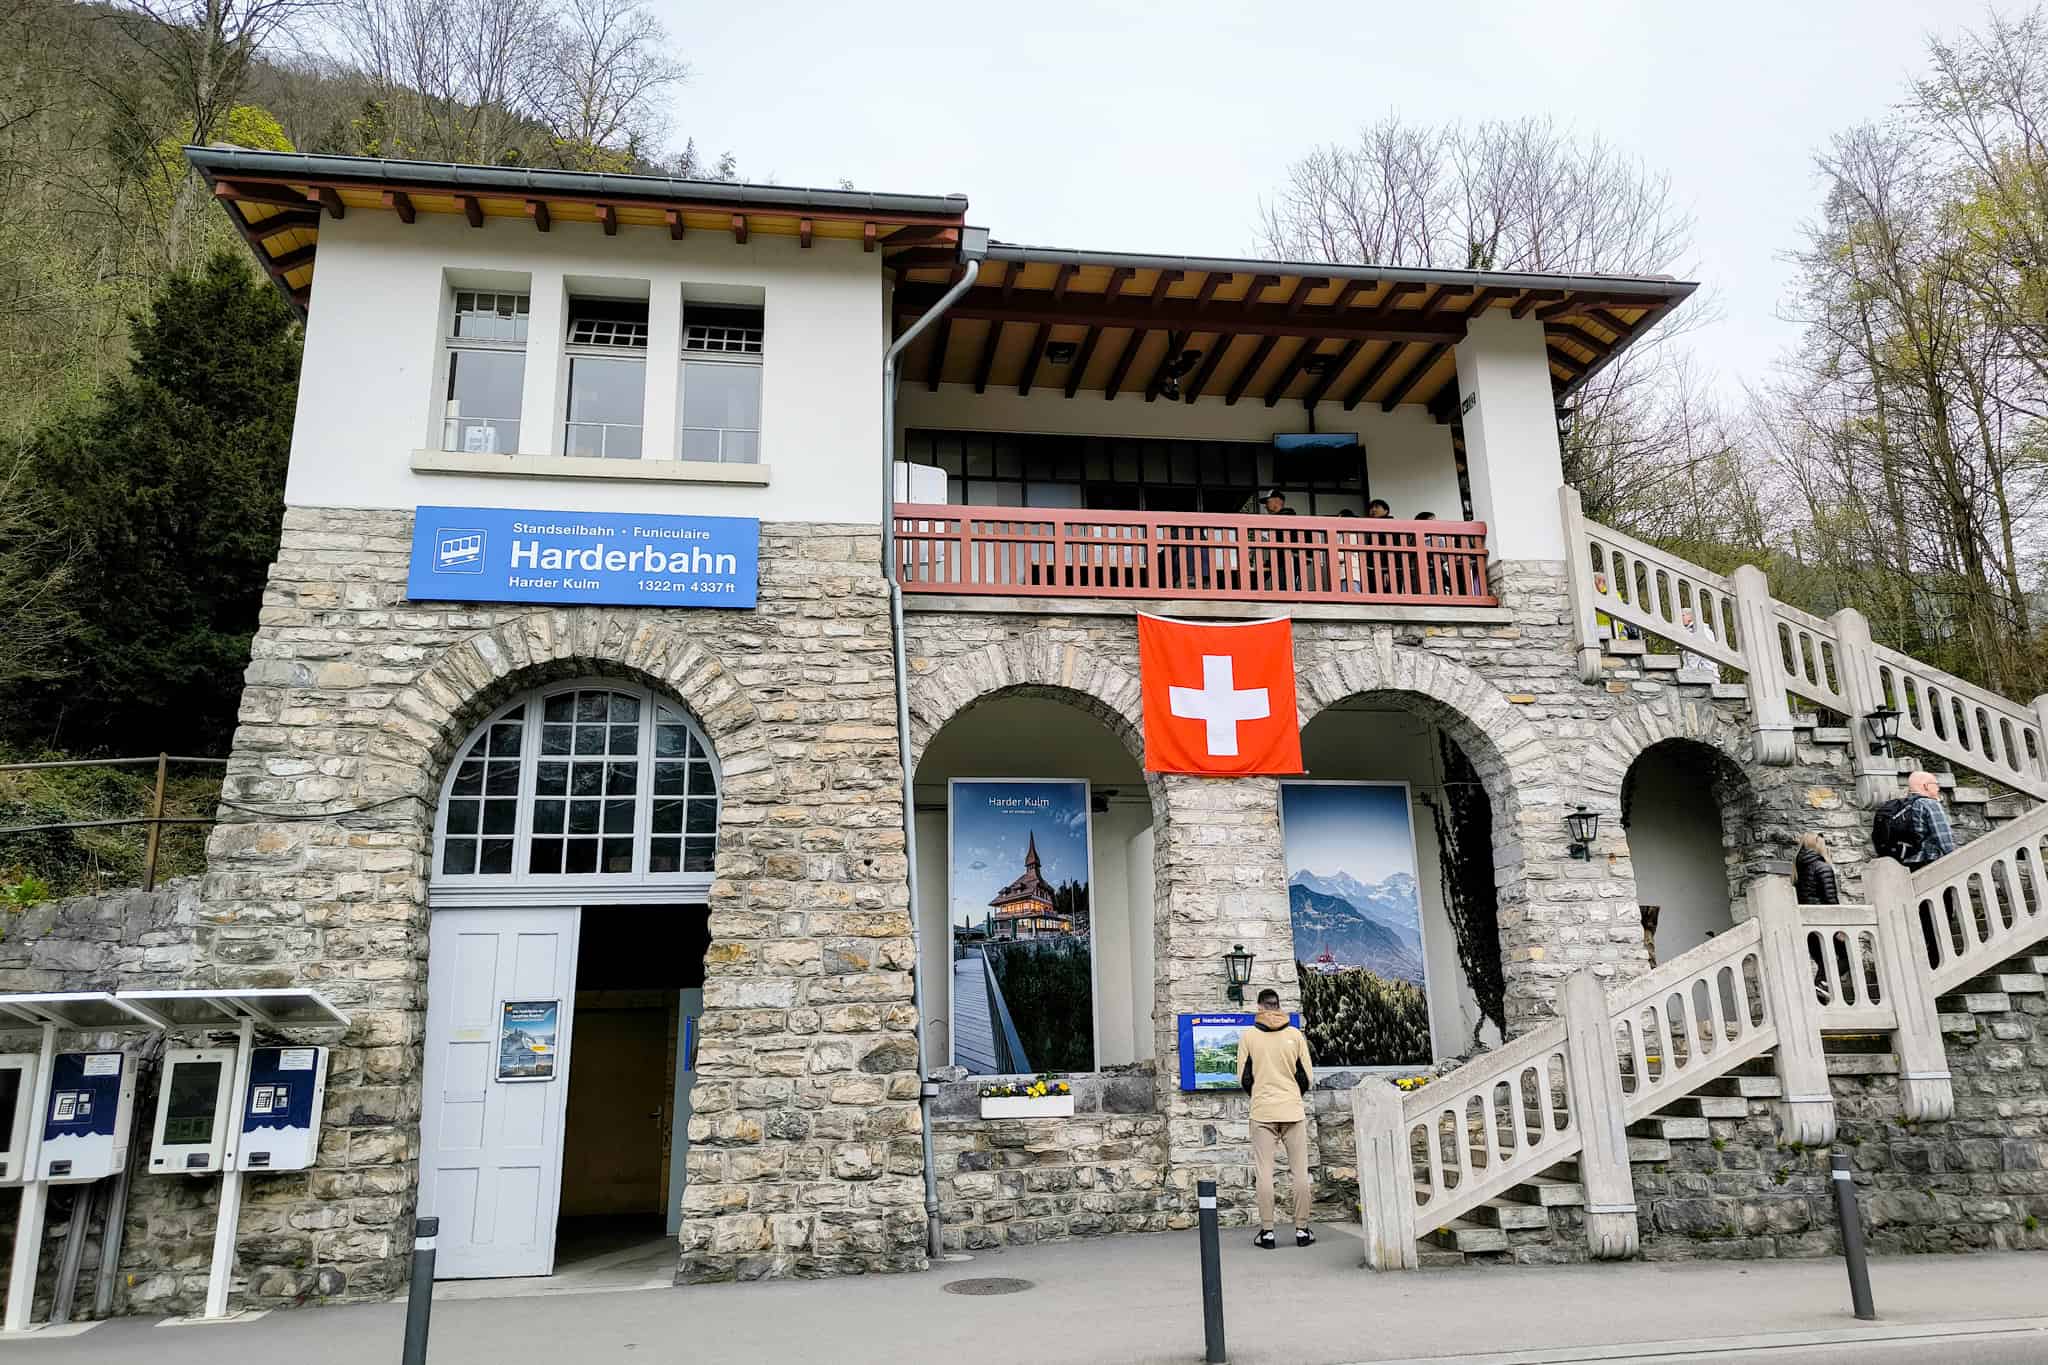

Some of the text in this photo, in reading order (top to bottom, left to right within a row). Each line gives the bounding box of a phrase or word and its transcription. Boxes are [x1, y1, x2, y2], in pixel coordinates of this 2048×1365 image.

[512, 522, 710, 540] Standseilbahn Funiculaire
[510, 540, 737, 575] Harderbahn
[509, 576, 600, 590] Harder Kulm
[988, 795, 1050, 807] Harder Kulm
